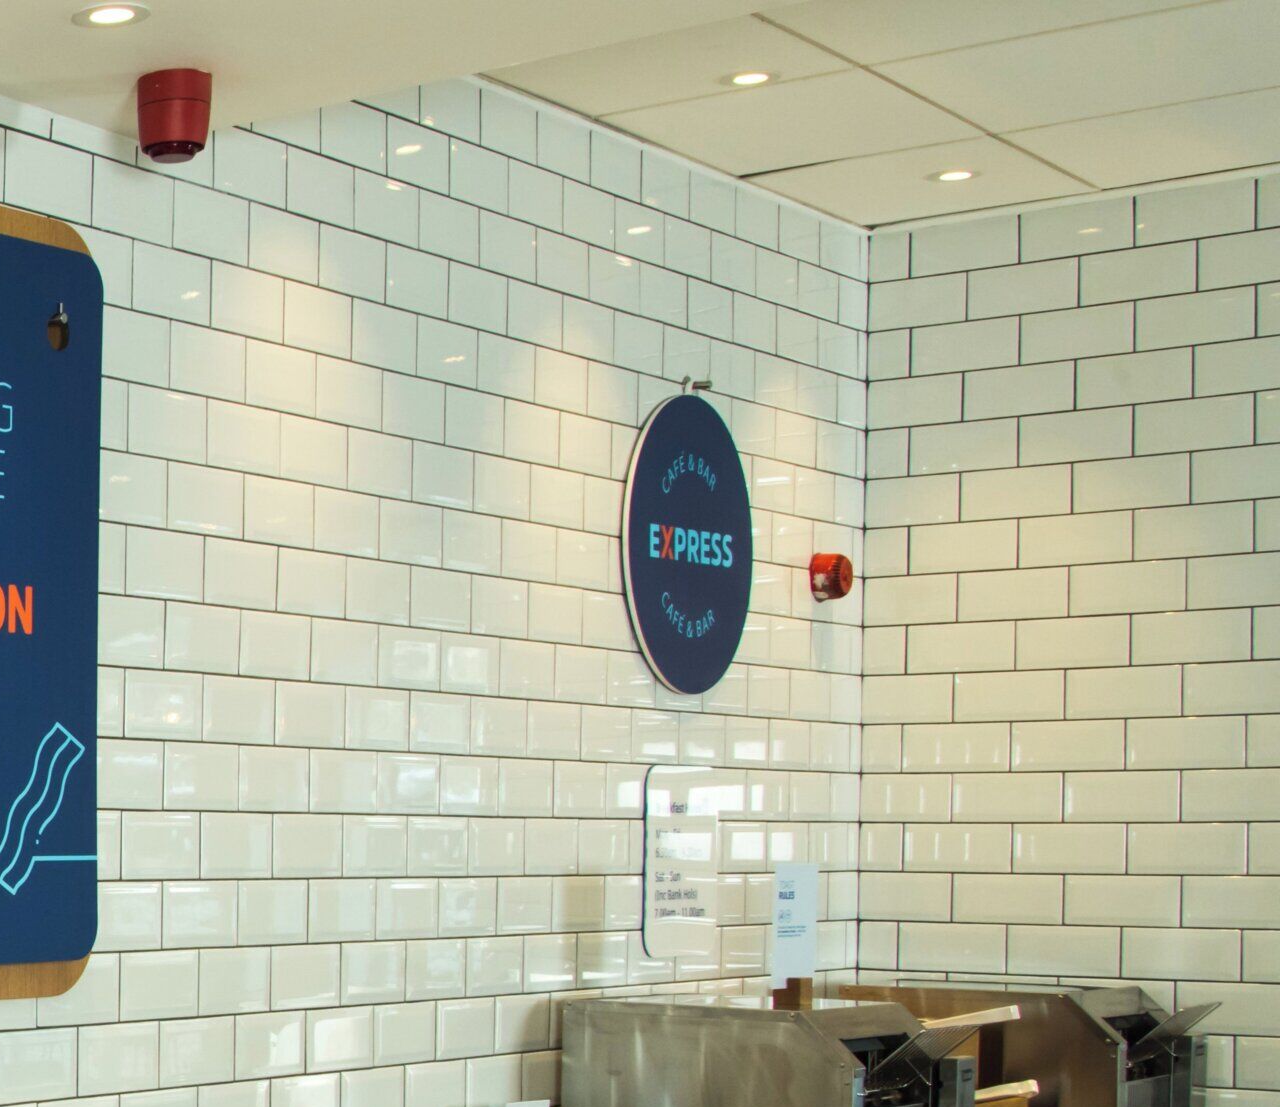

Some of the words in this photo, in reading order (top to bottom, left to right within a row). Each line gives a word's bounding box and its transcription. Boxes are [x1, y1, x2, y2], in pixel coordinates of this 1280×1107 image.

[697, 457, 716, 492] BAR
[649, 523, 733, 568] EXPRESS
[686, 620, 693, 638] &
[696, 609, 715, 638] BAR
